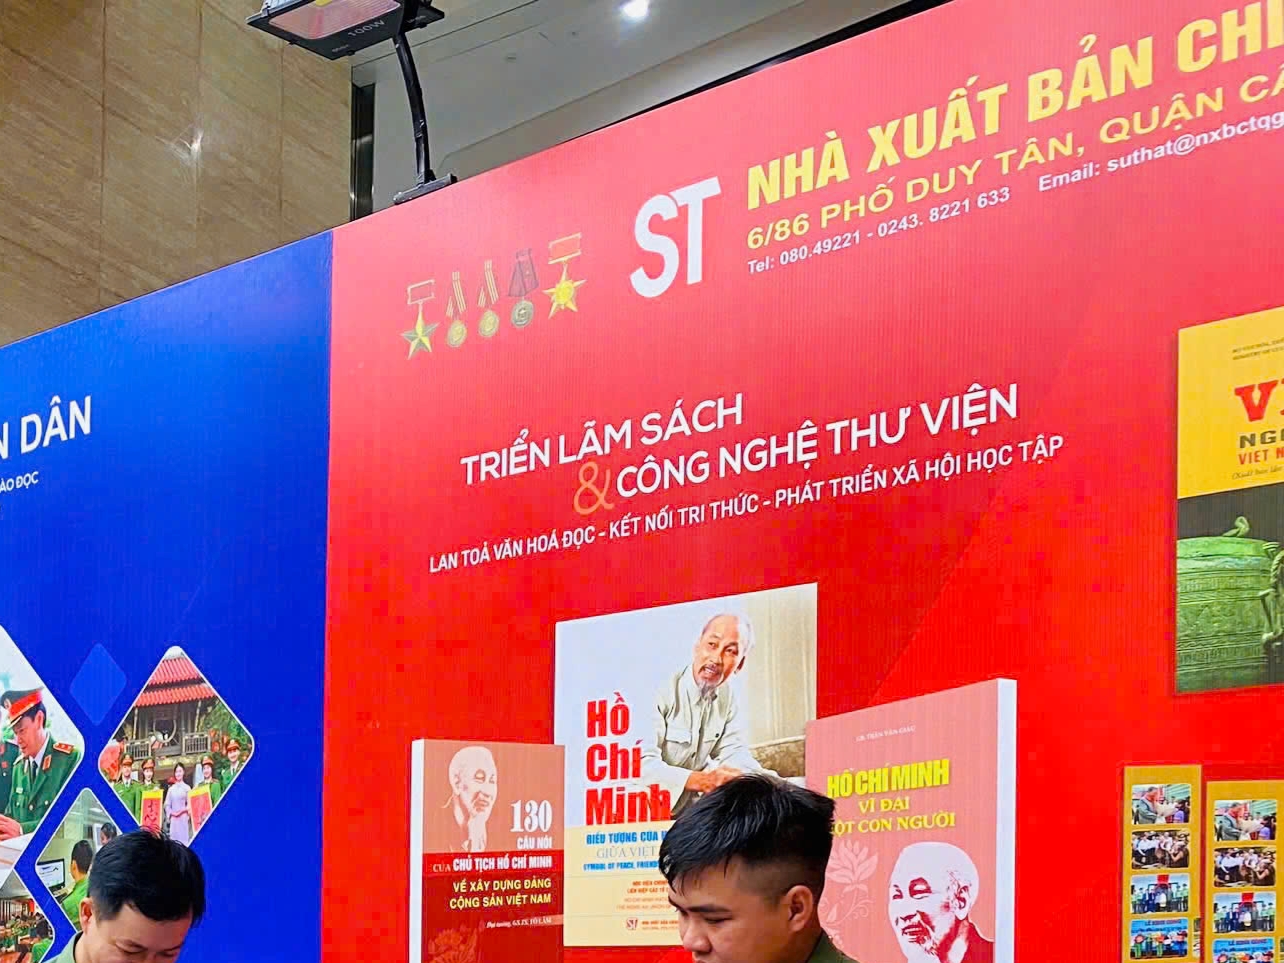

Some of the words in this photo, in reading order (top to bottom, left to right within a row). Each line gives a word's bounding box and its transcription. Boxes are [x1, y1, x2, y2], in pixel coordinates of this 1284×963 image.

[347, 19, 386, 37] 100W
[747, 130, 849, 210] NHÀ
[868, 75, 1009, 173] XUẤT
[1029, 34, 1153, 122] BẢN
[748, 214, 809, 250] 6/86
[821, 176, 897, 229] PHỐ
[906, 160, 984, 205] DUY
[996, 133, 1085, 176] TÂN,
[1101, 84, 1226, 144] QUẬN
[630, 177, 721, 298] ST
[748, 254, 774, 275] Tel:
[780, 229, 861, 266] 080.49221
[877, 215, 923, 242] 0243.
[929, 200, 972, 223] 8221
[977, 188, 1011, 209] 633
[1039, 160, 1102, 192] Email:
[21, 394, 94, 454] DÂN
[460, 429, 550, 485] TRIỂN
[559, 421, 633, 466] LÃM
[641, 393, 744, 446] SÁCH
[617, 455, 710, 500] CÔNG
[718, 424, 819, 478] NGHỆ
[825, 406, 911, 455] THƯ
[923, 382, 1018, 440] VIỆN
[16, 470, 40, 491] ĐỌC
[574, 463, 614, 514] &
[429, 553, 459, 574] LAN
[461, 541, 491, 567] TOẢ
[493, 535, 524, 562] VĂN
[526, 527, 560, 554] HOÁ
[562, 526, 596, 550] ĐỌC
[609, 512, 640, 538] KẾT
[645, 503, 673, 533] NỐI
[678, 503, 705, 527] TRI
[710, 493, 760, 521] THỨC
[775, 478, 823, 509] PHÁT
[829, 465, 886, 497] TRIỂN
[892, 457, 920, 482] XÃ
[925, 451, 961, 482] HỘI
[966, 443, 1014, 475] HỌC
[1019, 434, 1064, 465] TẬP
[587, 691, 630, 738] Hồ
[587, 739, 644, 782] Chí
[827, 766, 853, 798] HỒ
[855, 762, 888, 795] CHÍ
[890, 758, 950, 791] MINH
[510, 800, 553, 832] 130
[586, 784, 671, 826] Minh
[858, 818, 892, 834] CON
[897, 812, 956, 830] NGƯỜI
[880, 796, 910, 812] ĐẠI
[517, 836, 535, 850] CÂU
[537, 834, 552, 849] NÓI
[608, 831, 637, 845] TƯỢNG
[453, 855, 472, 872] CHỦ
[475, 855, 495, 873] TỊCH
[497, 853, 509, 869] HỒ
[512, 853, 527, 869] CHÍ
[529, 855, 552, 868] MINH
[450, 894, 480, 911] CỘNG
[483, 893, 503, 908] SẢN
[506, 893, 528, 907] VIỆT
[530, 893, 551, 904] NAM
[453, 877, 467, 893] VỀ
[470, 878, 490, 893] XÂY
[493, 878, 521, 895] DỰNG
[524, 875, 551, 889] ĐẢNG
